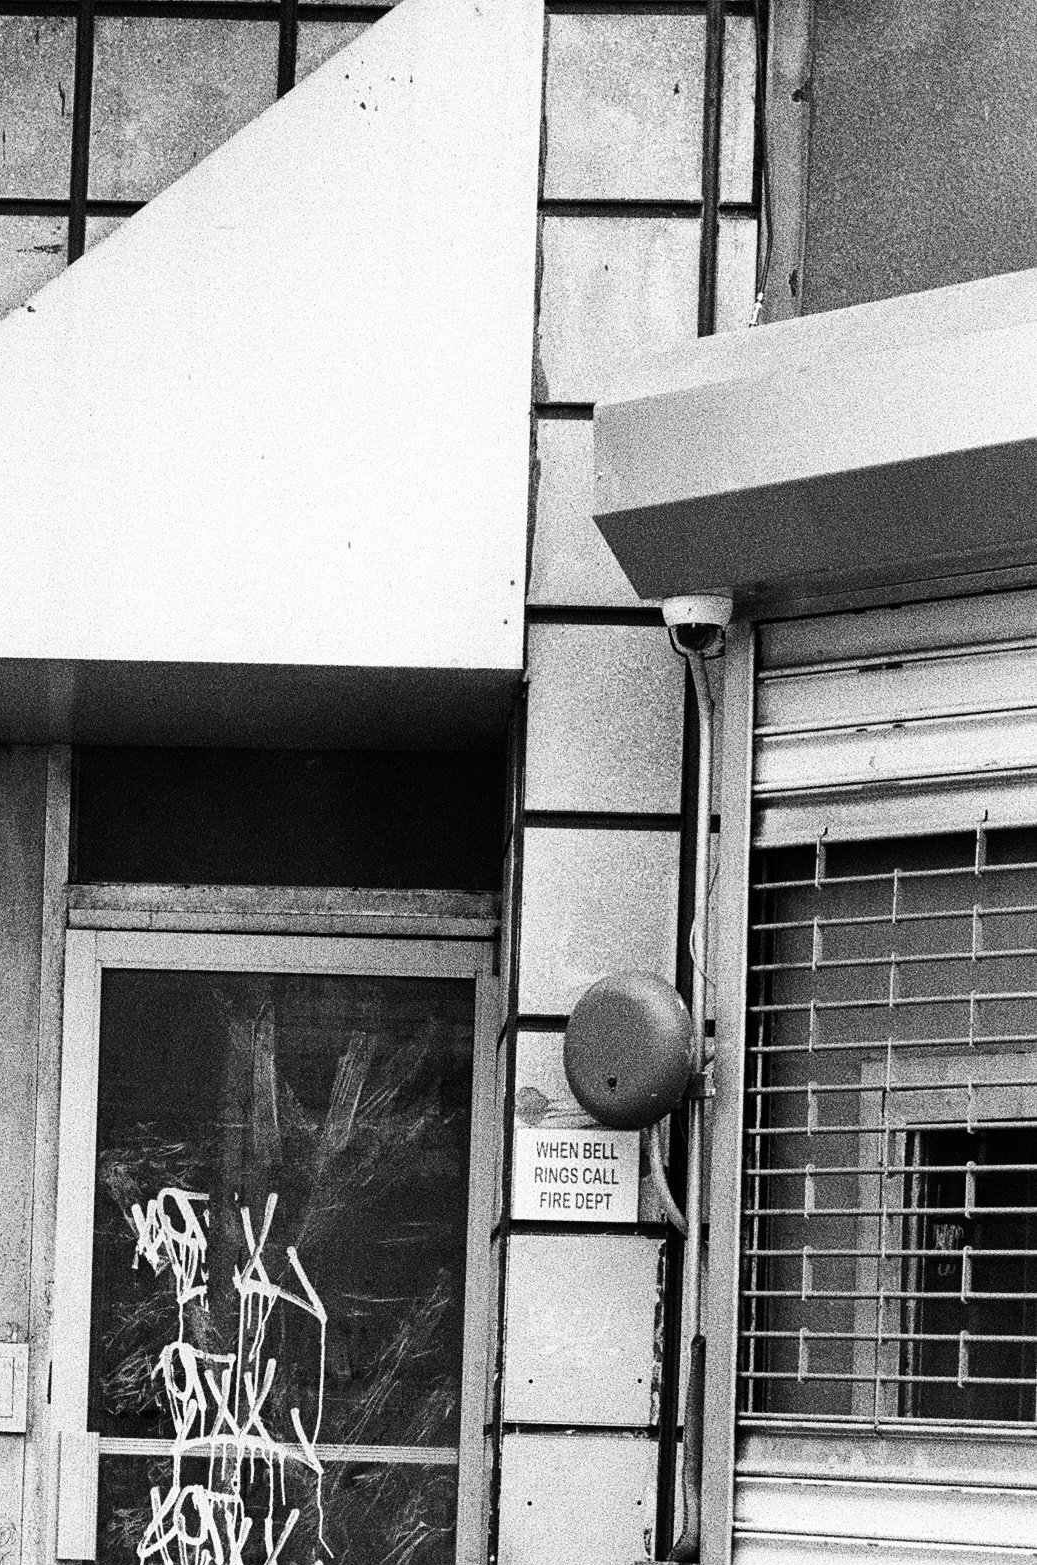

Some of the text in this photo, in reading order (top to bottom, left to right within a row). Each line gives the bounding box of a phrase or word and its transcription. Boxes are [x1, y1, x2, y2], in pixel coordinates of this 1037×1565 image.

[536, 1141, 618, 1160] WHEN BELL
[534, 1166, 619, 1185] RINGS CALL
[539, 1192, 613, 1210] FIRE DEPT
